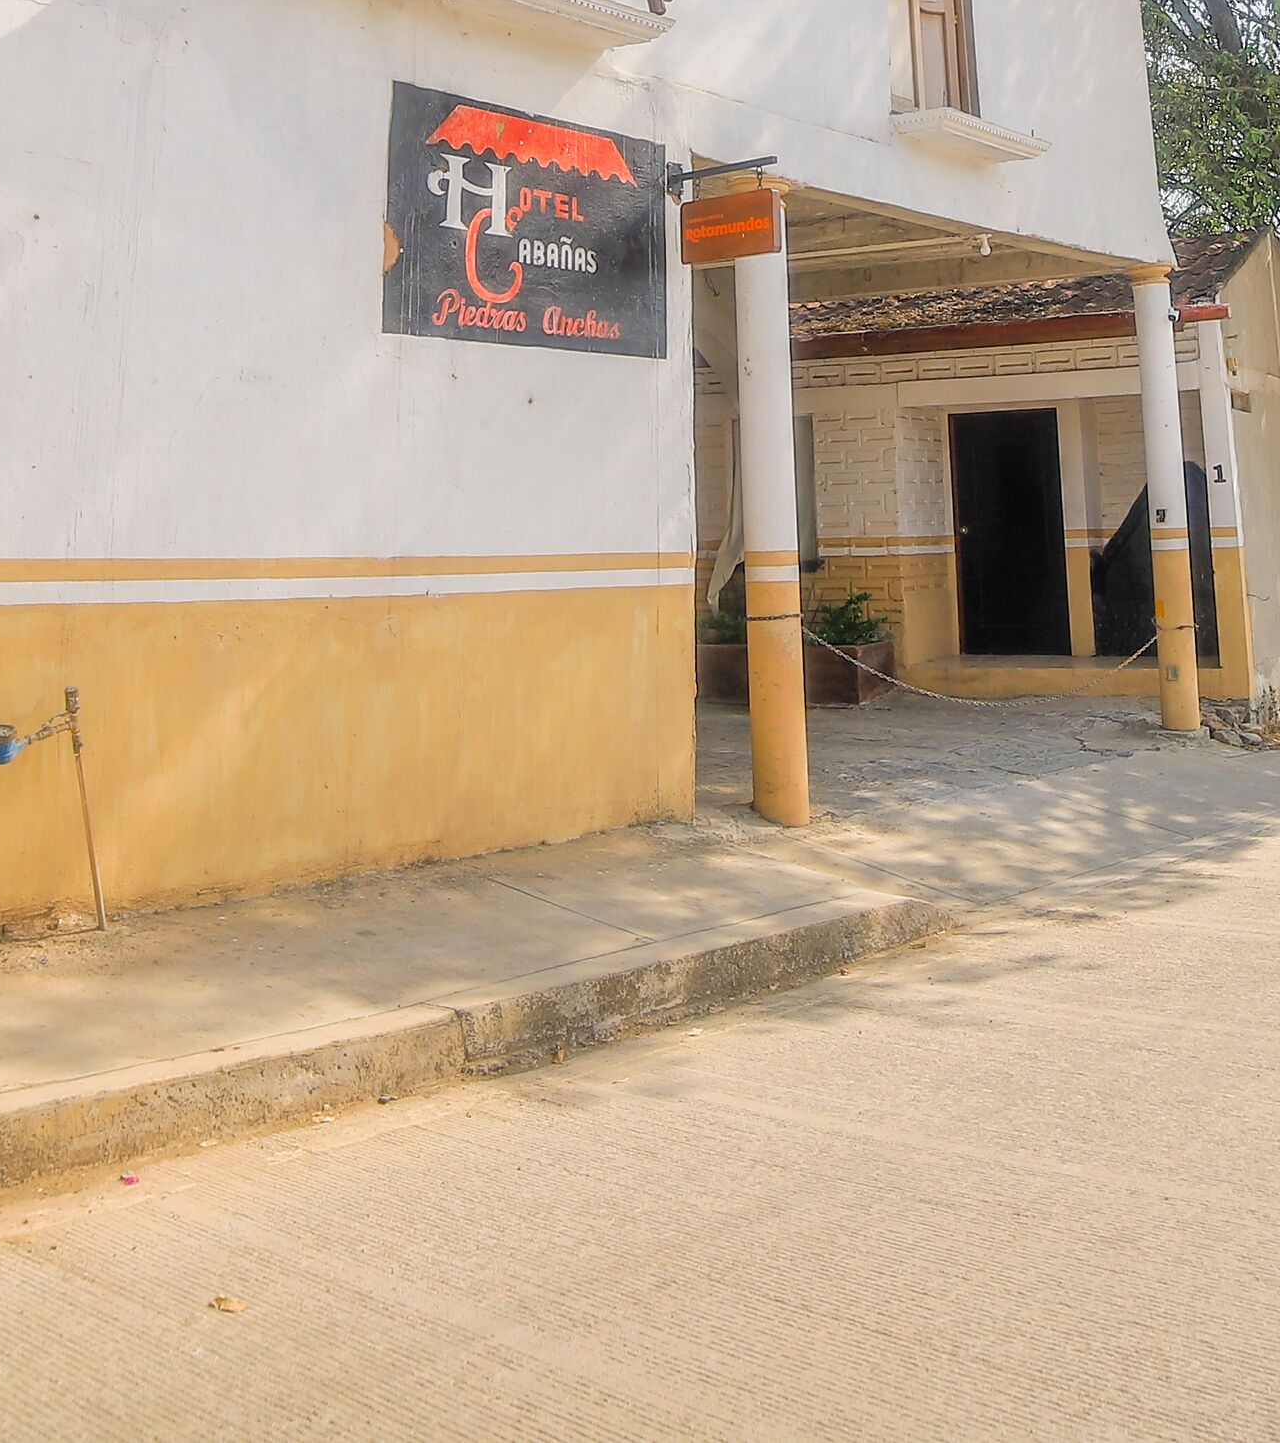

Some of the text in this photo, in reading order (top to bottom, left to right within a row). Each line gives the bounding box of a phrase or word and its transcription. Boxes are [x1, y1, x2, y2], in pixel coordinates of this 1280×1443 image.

[426, 152, 585, 238] HOTEL
[465, 206, 599, 304] CABAÑAS
[685, 216, 770, 243] Rotamundos
[431, 287, 620, 340] Piedras Anchas
[1213, 465, 1226, 483] 1
